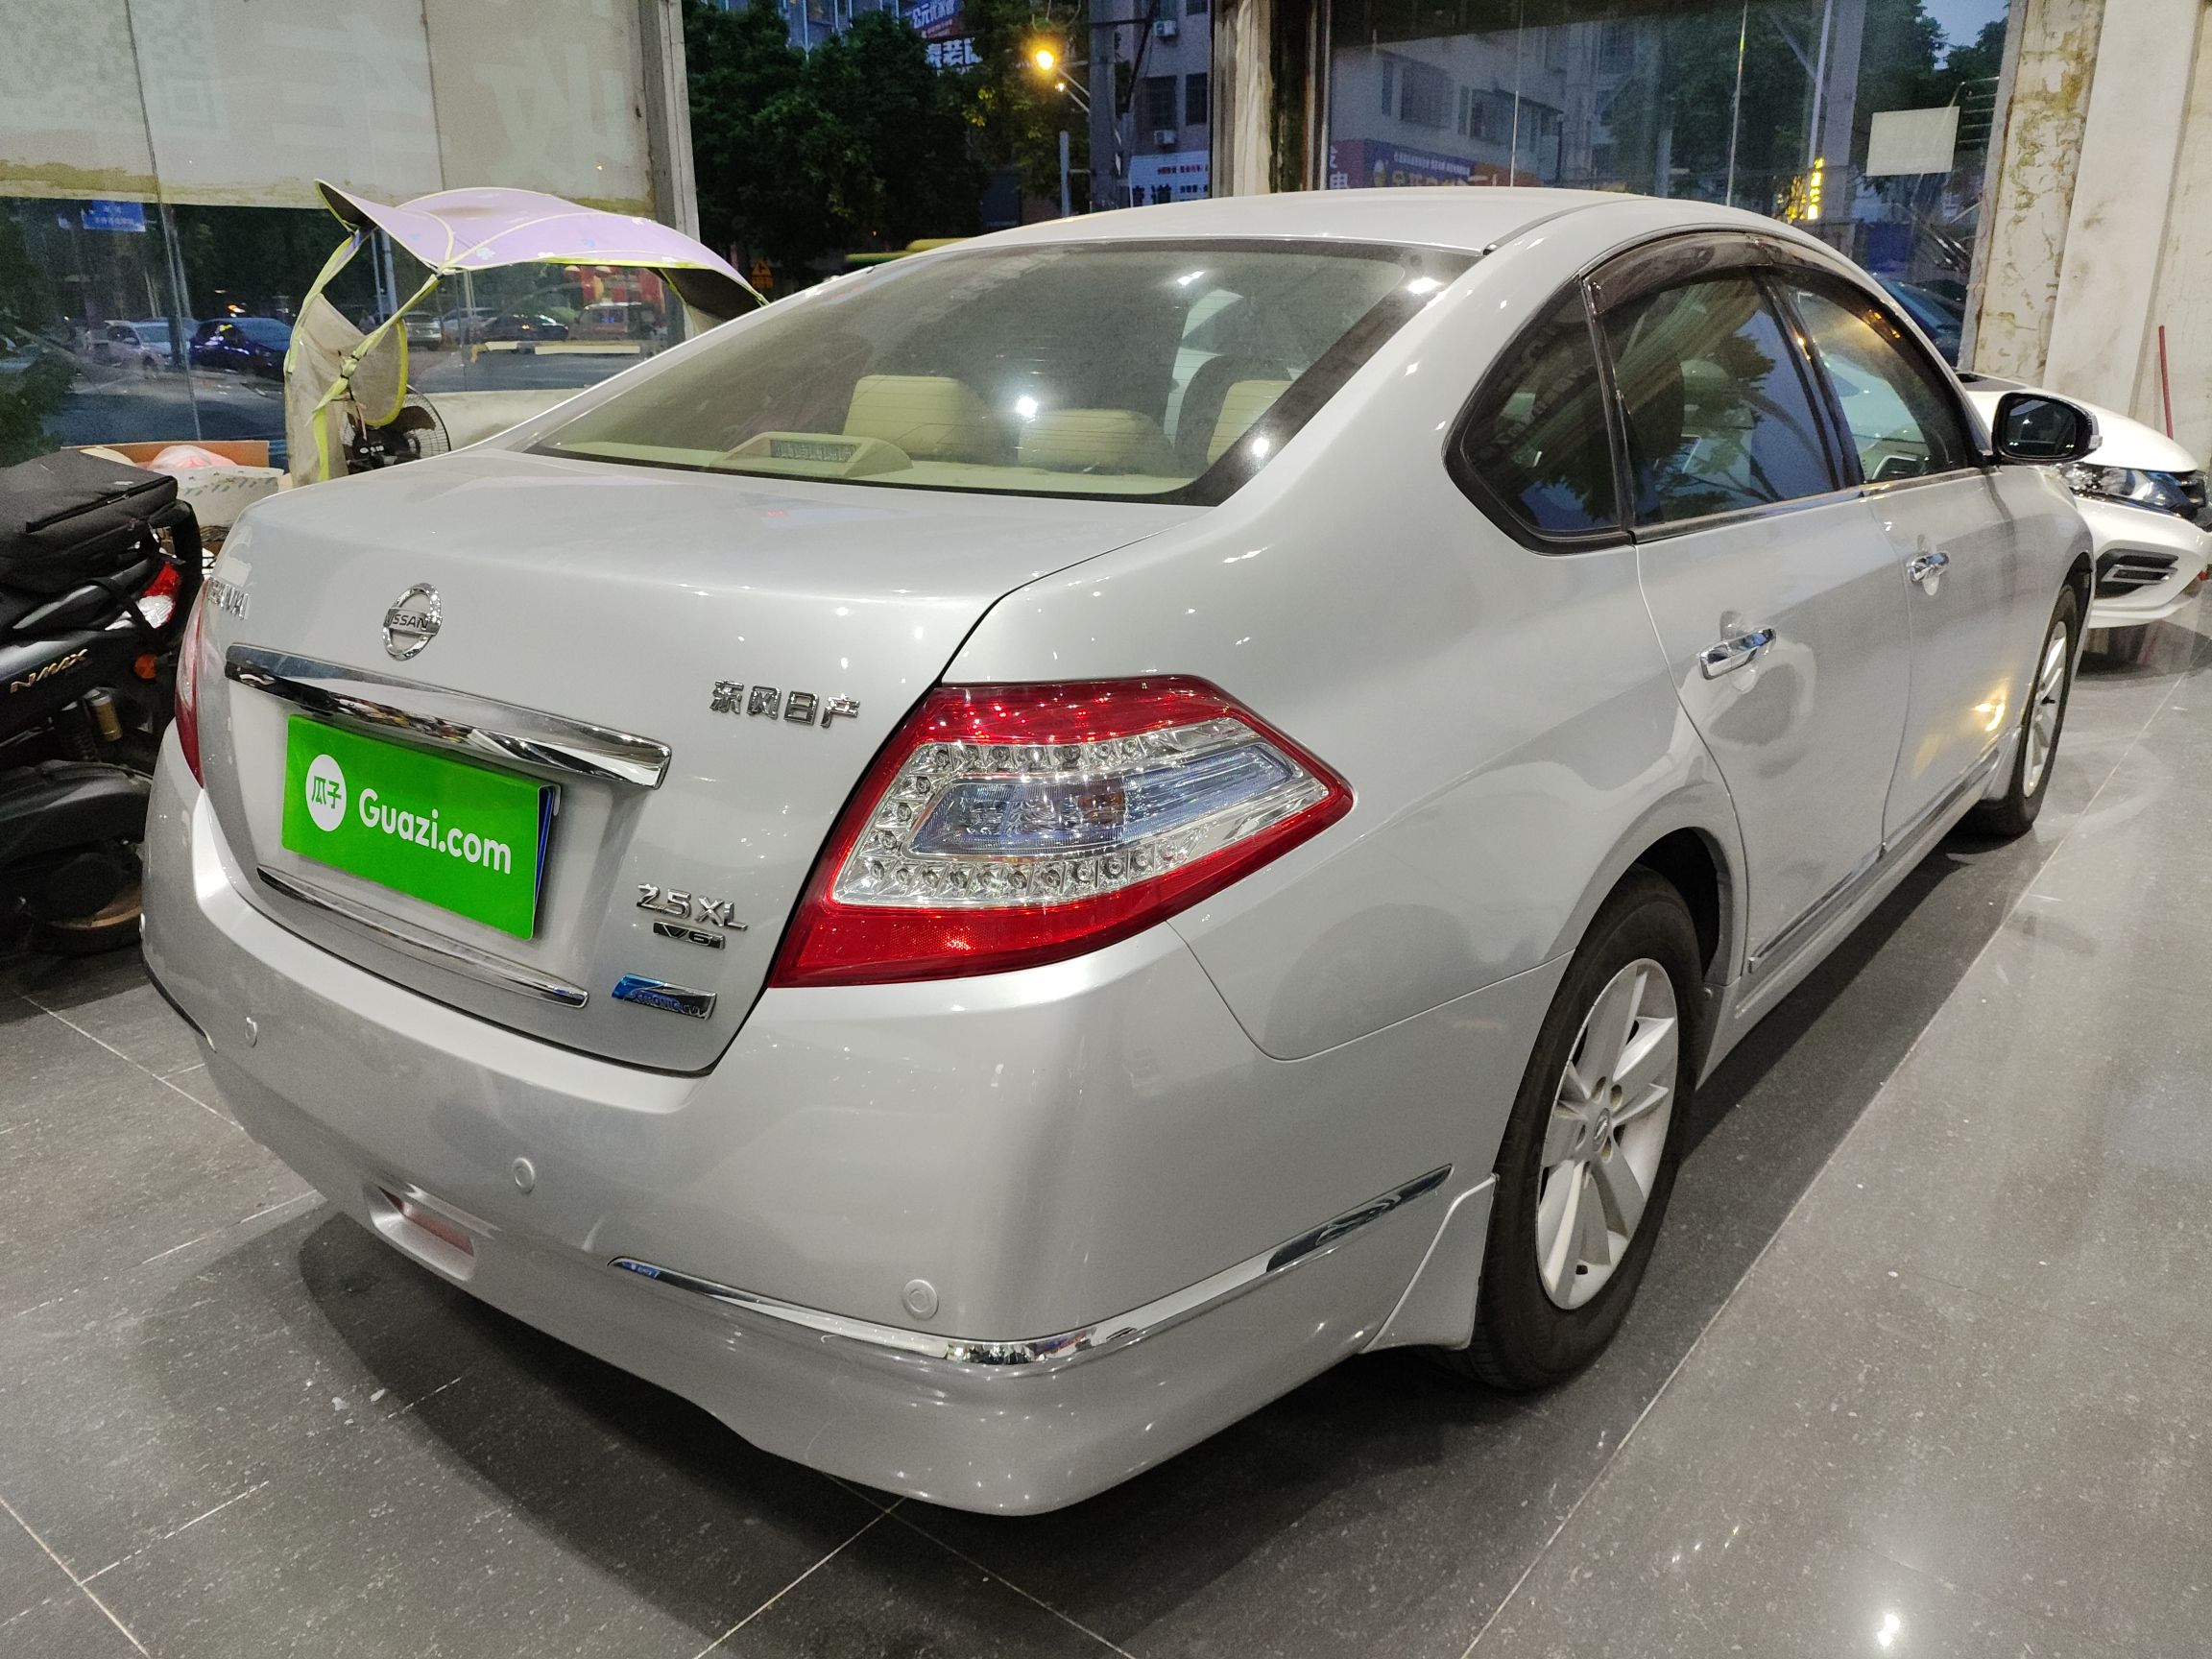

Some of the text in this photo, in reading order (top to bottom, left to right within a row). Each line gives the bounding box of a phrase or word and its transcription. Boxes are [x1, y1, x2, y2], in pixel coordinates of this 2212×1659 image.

[709, 679, 860, 729] 东风日产
[311, 775, 342, 809] 瓜子
[359, 788, 512, 875] Guazi.com
[662, 923, 713, 946] V6
